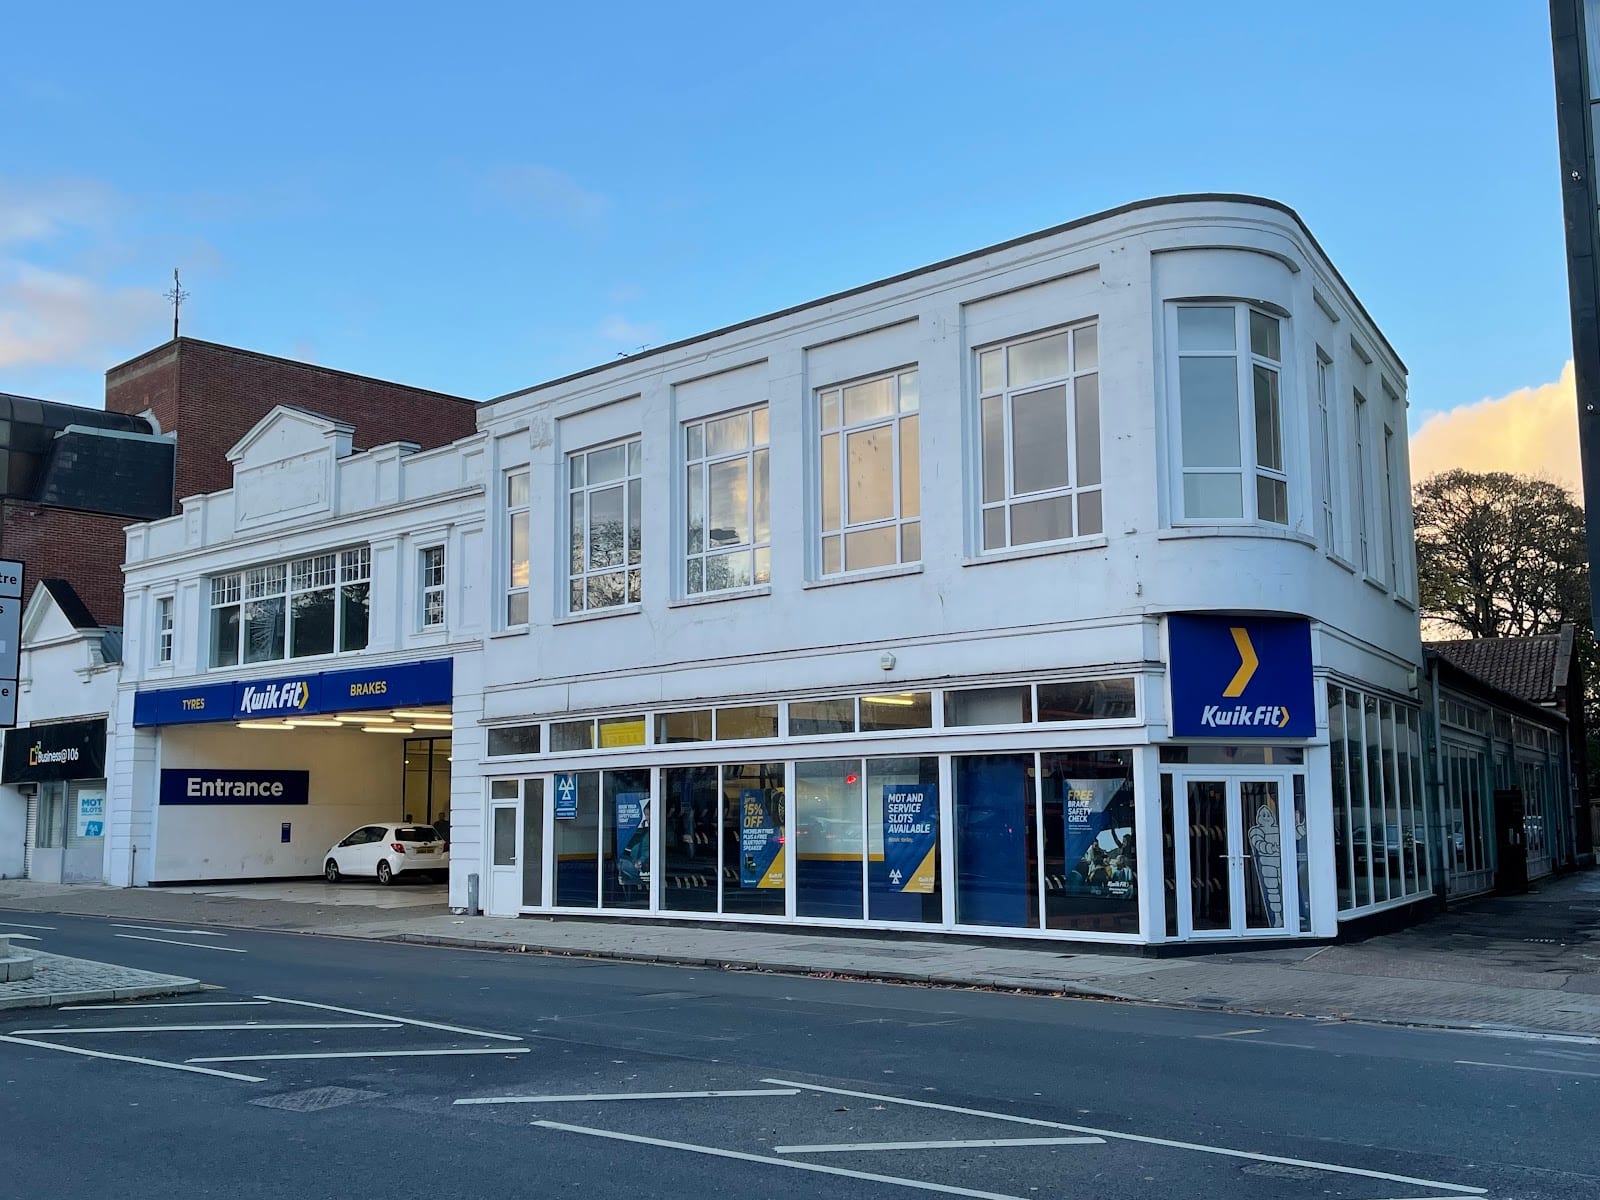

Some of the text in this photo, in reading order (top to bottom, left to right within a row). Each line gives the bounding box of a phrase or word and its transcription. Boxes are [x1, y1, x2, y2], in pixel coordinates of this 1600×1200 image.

[350, 681, 387, 697] BRAKES
[182, 698, 205, 710] TYRES
[187, 778, 284, 797] Entrance
[888, 793, 924, 803] MOT AND
[1068, 790, 1093, 800] FREE
[81, 799, 103, 807] MOT
[888, 803, 921, 813] SERVICE
[743, 803, 763, 816] 15%
[1068, 807, 1093, 815] SAFETY
[743, 816, 764, 828] OFF
[888, 813, 914, 823] SLOTS
[1068, 815, 1088, 823] CHECK
[888, 824, 931, 834] AVAILABLE
